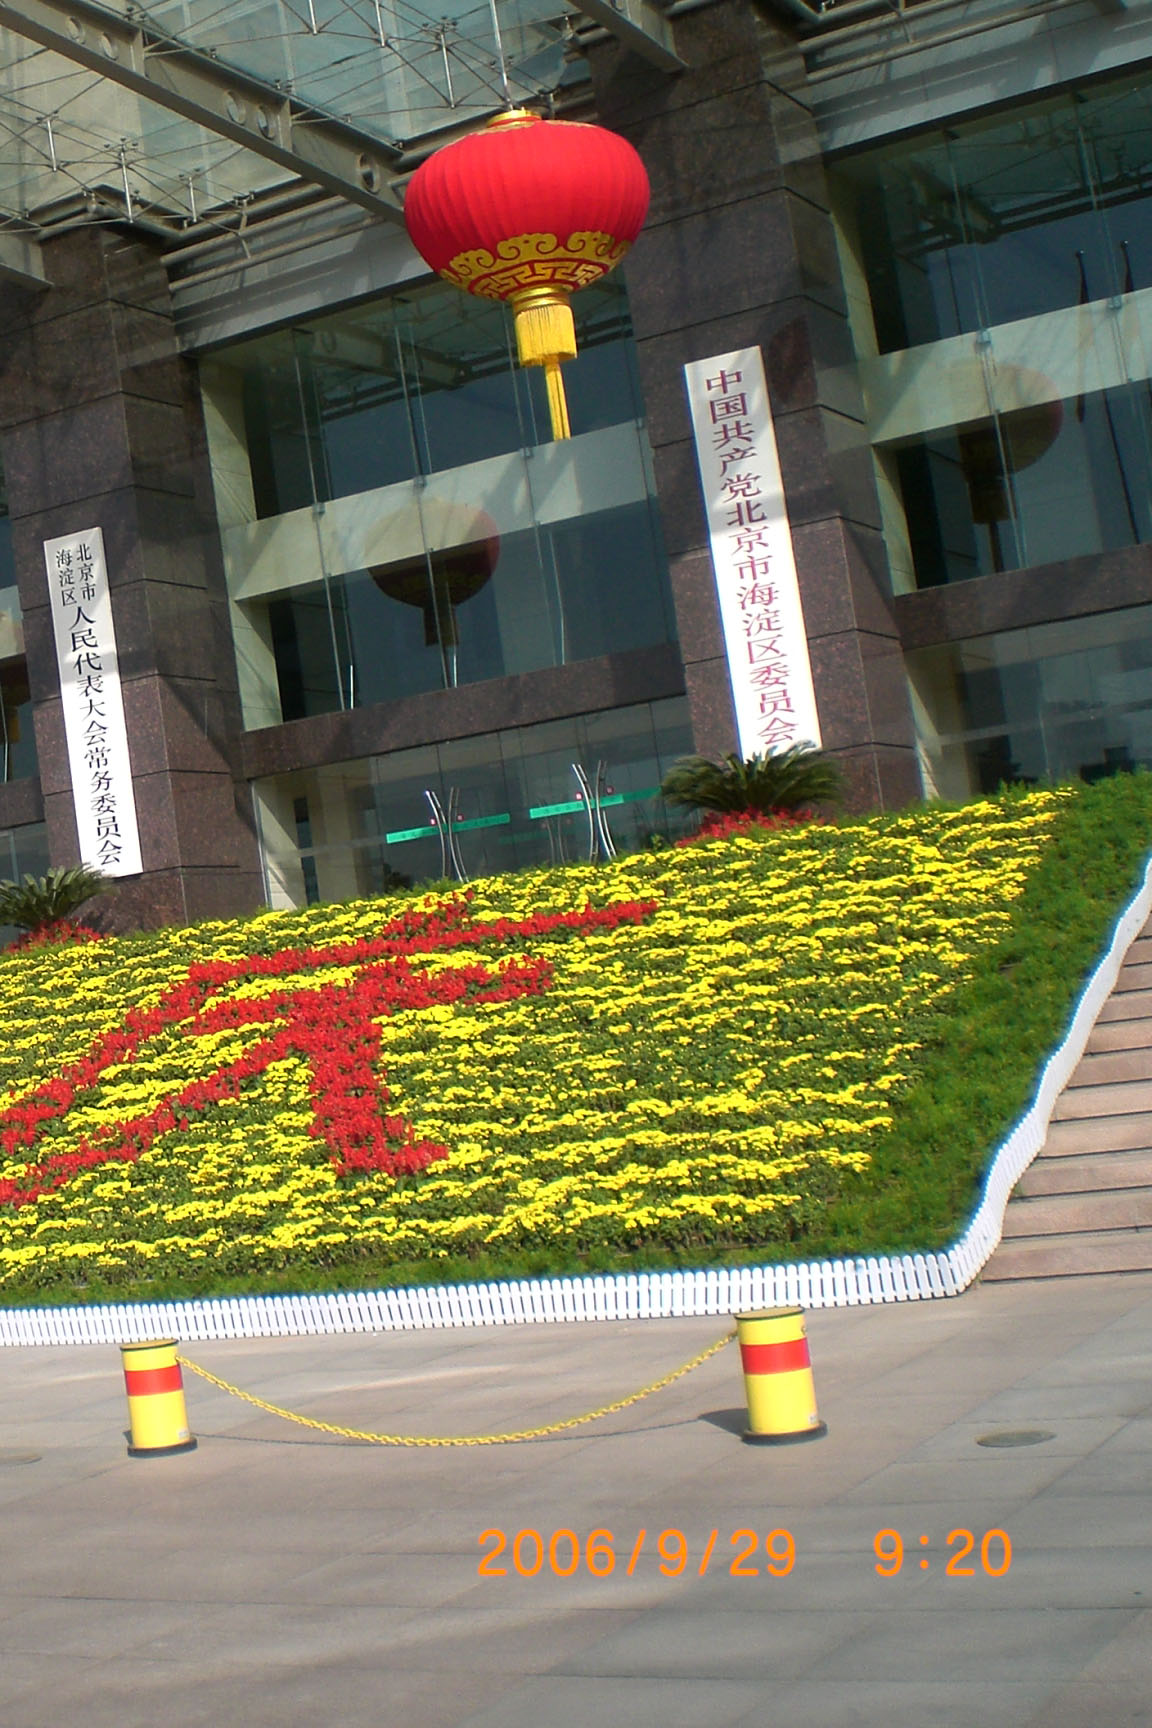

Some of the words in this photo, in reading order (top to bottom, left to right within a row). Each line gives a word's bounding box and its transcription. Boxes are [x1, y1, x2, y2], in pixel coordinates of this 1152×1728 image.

[55, 549, 77, 607] 海淀区
[76, 543, 96, 602] 北京市
[705, 369, 797, 745] 中国共产党北京市海淀区委员会
[68, 605, 123, 866] 人民代表大会常务委员会
